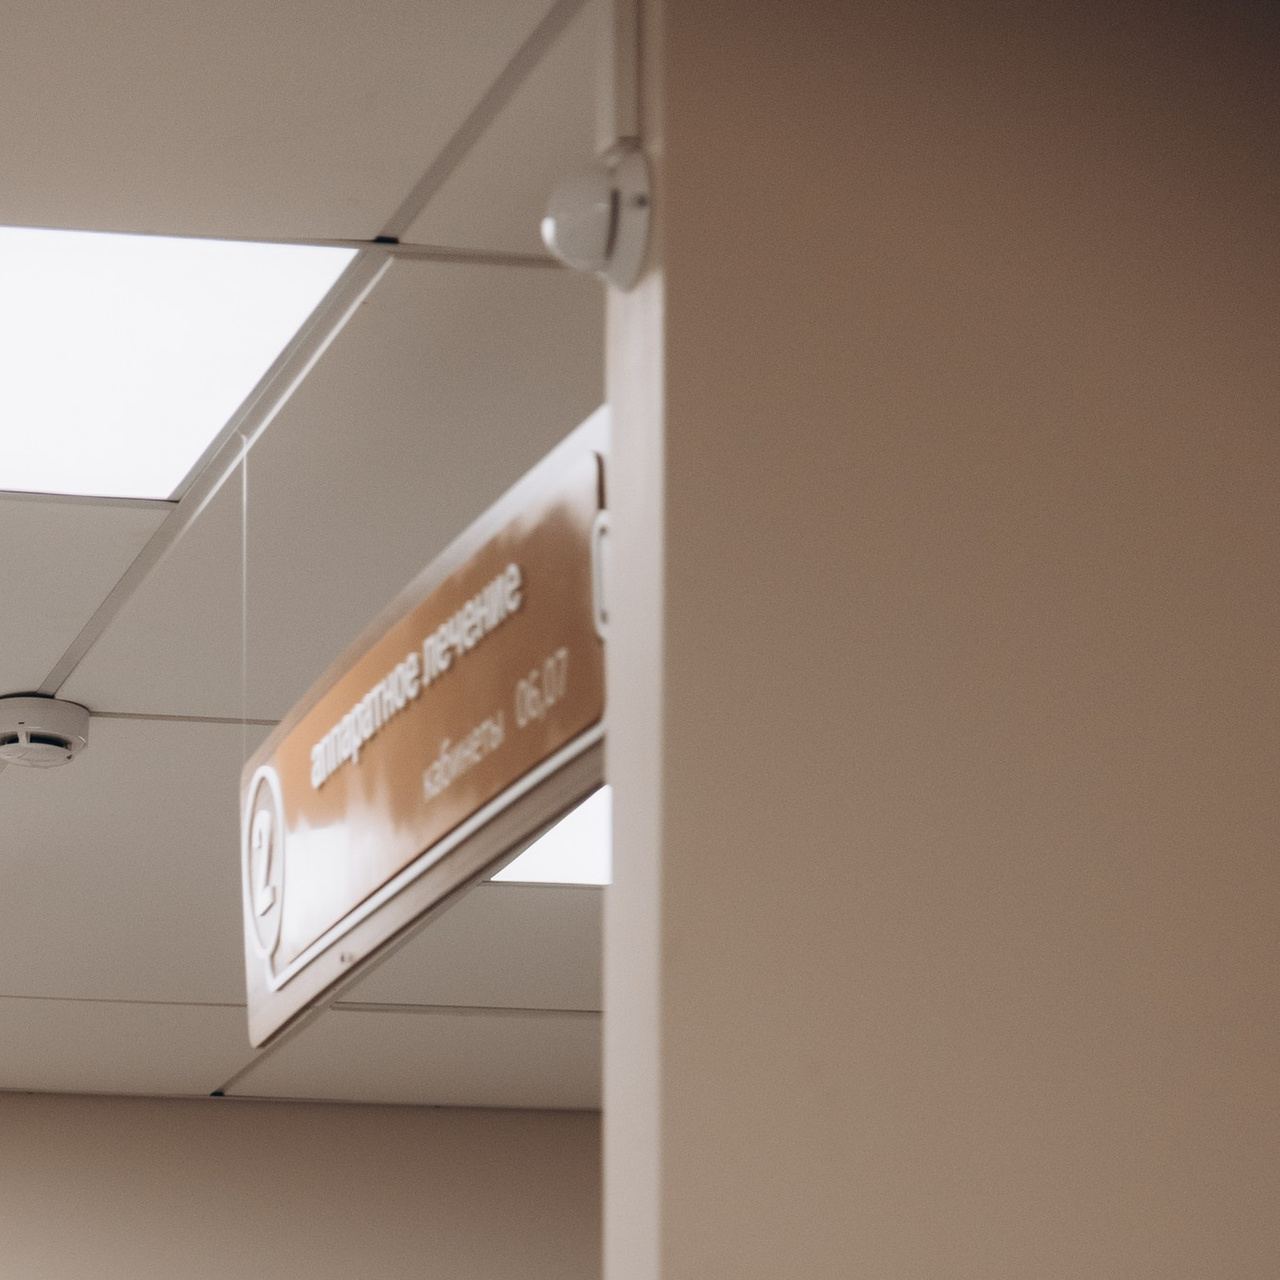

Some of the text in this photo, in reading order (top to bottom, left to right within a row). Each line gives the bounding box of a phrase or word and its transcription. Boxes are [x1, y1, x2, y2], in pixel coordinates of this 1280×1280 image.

[308, 562, 522, 791] аппаратное лечение
[422, 707, 505, 800] кабинеты
[252, 808, 276, 917] 2
